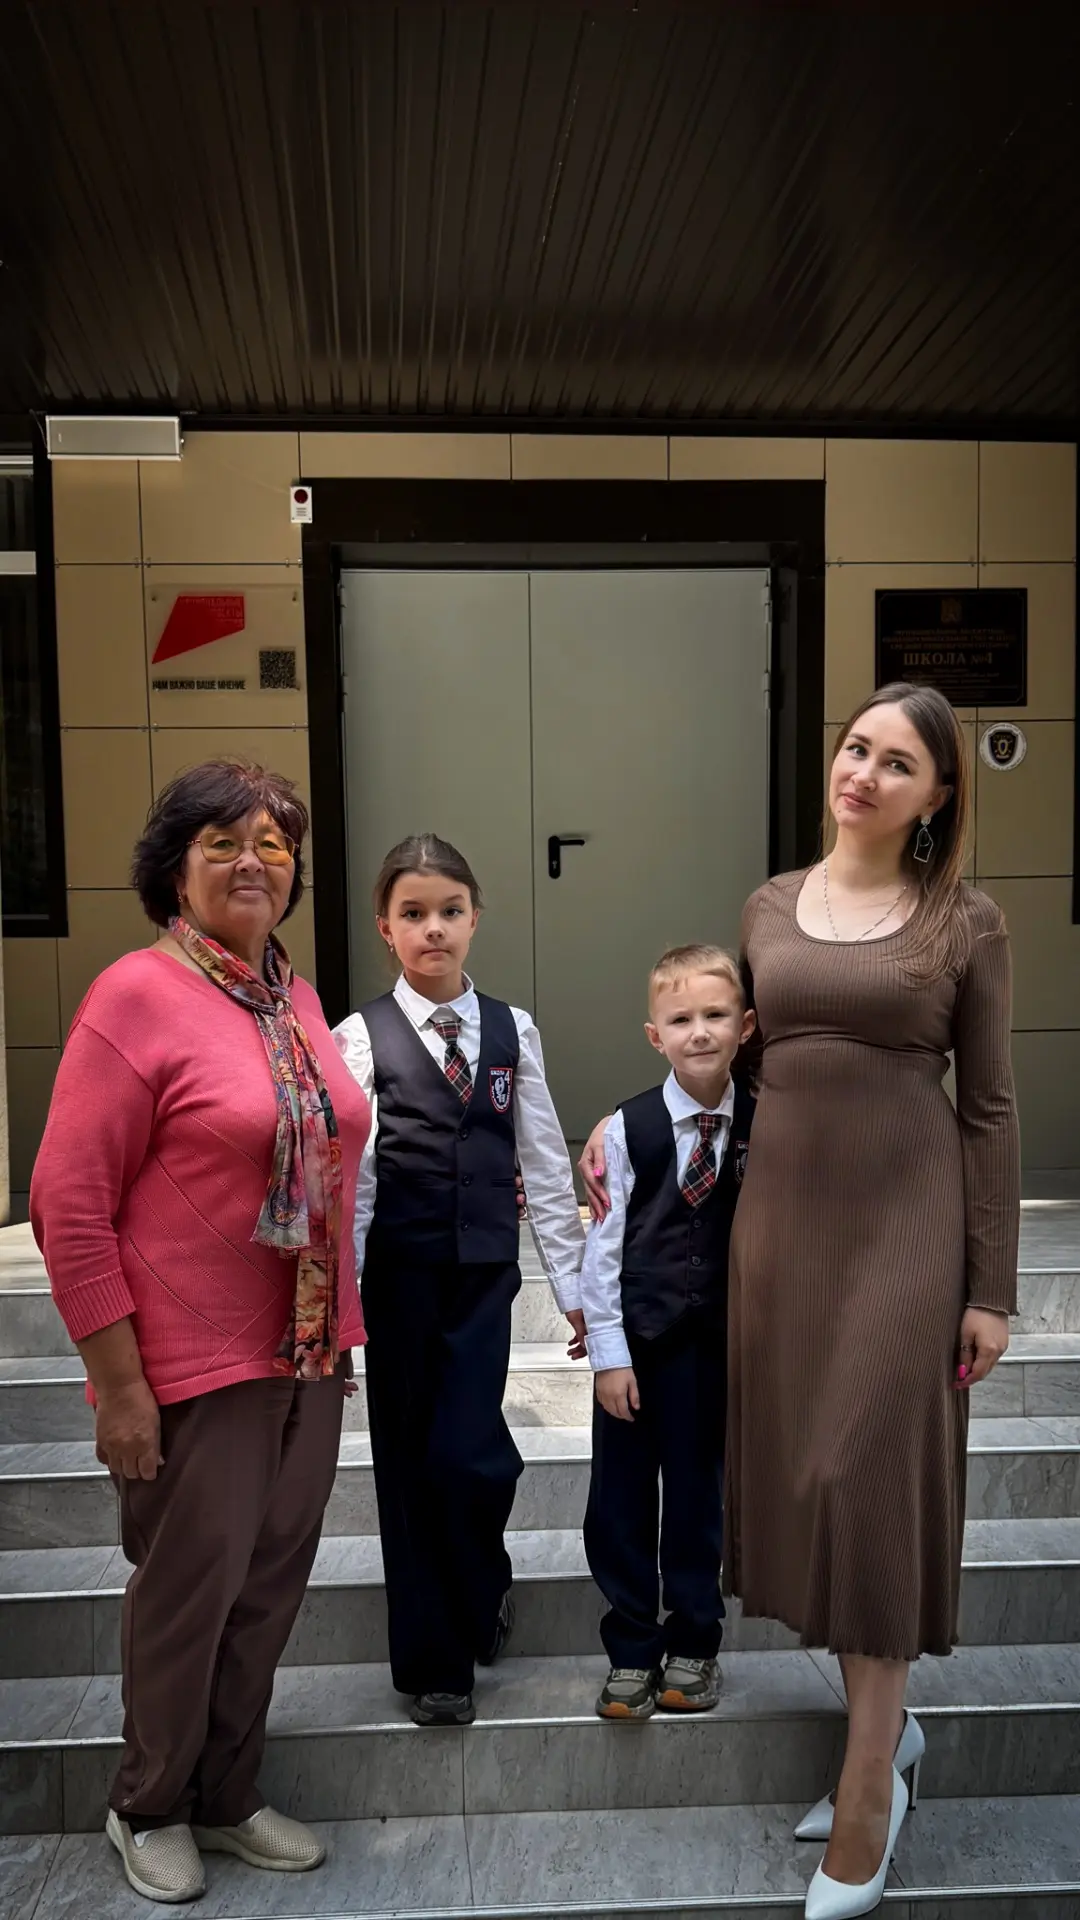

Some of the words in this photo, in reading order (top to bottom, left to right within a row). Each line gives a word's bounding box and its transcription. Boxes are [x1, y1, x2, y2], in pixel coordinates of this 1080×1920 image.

[903, 652, 967, 666] ШКОЛА
[152, 680, 168, 690] НАМ
[169, 680, 194, 690] ВАЖНО
[196, 680, 216, 690] ВАШЕ
[217, 680, 245, 690] МНЕНИЕ
[504, 1070, 510, 1084] 4
